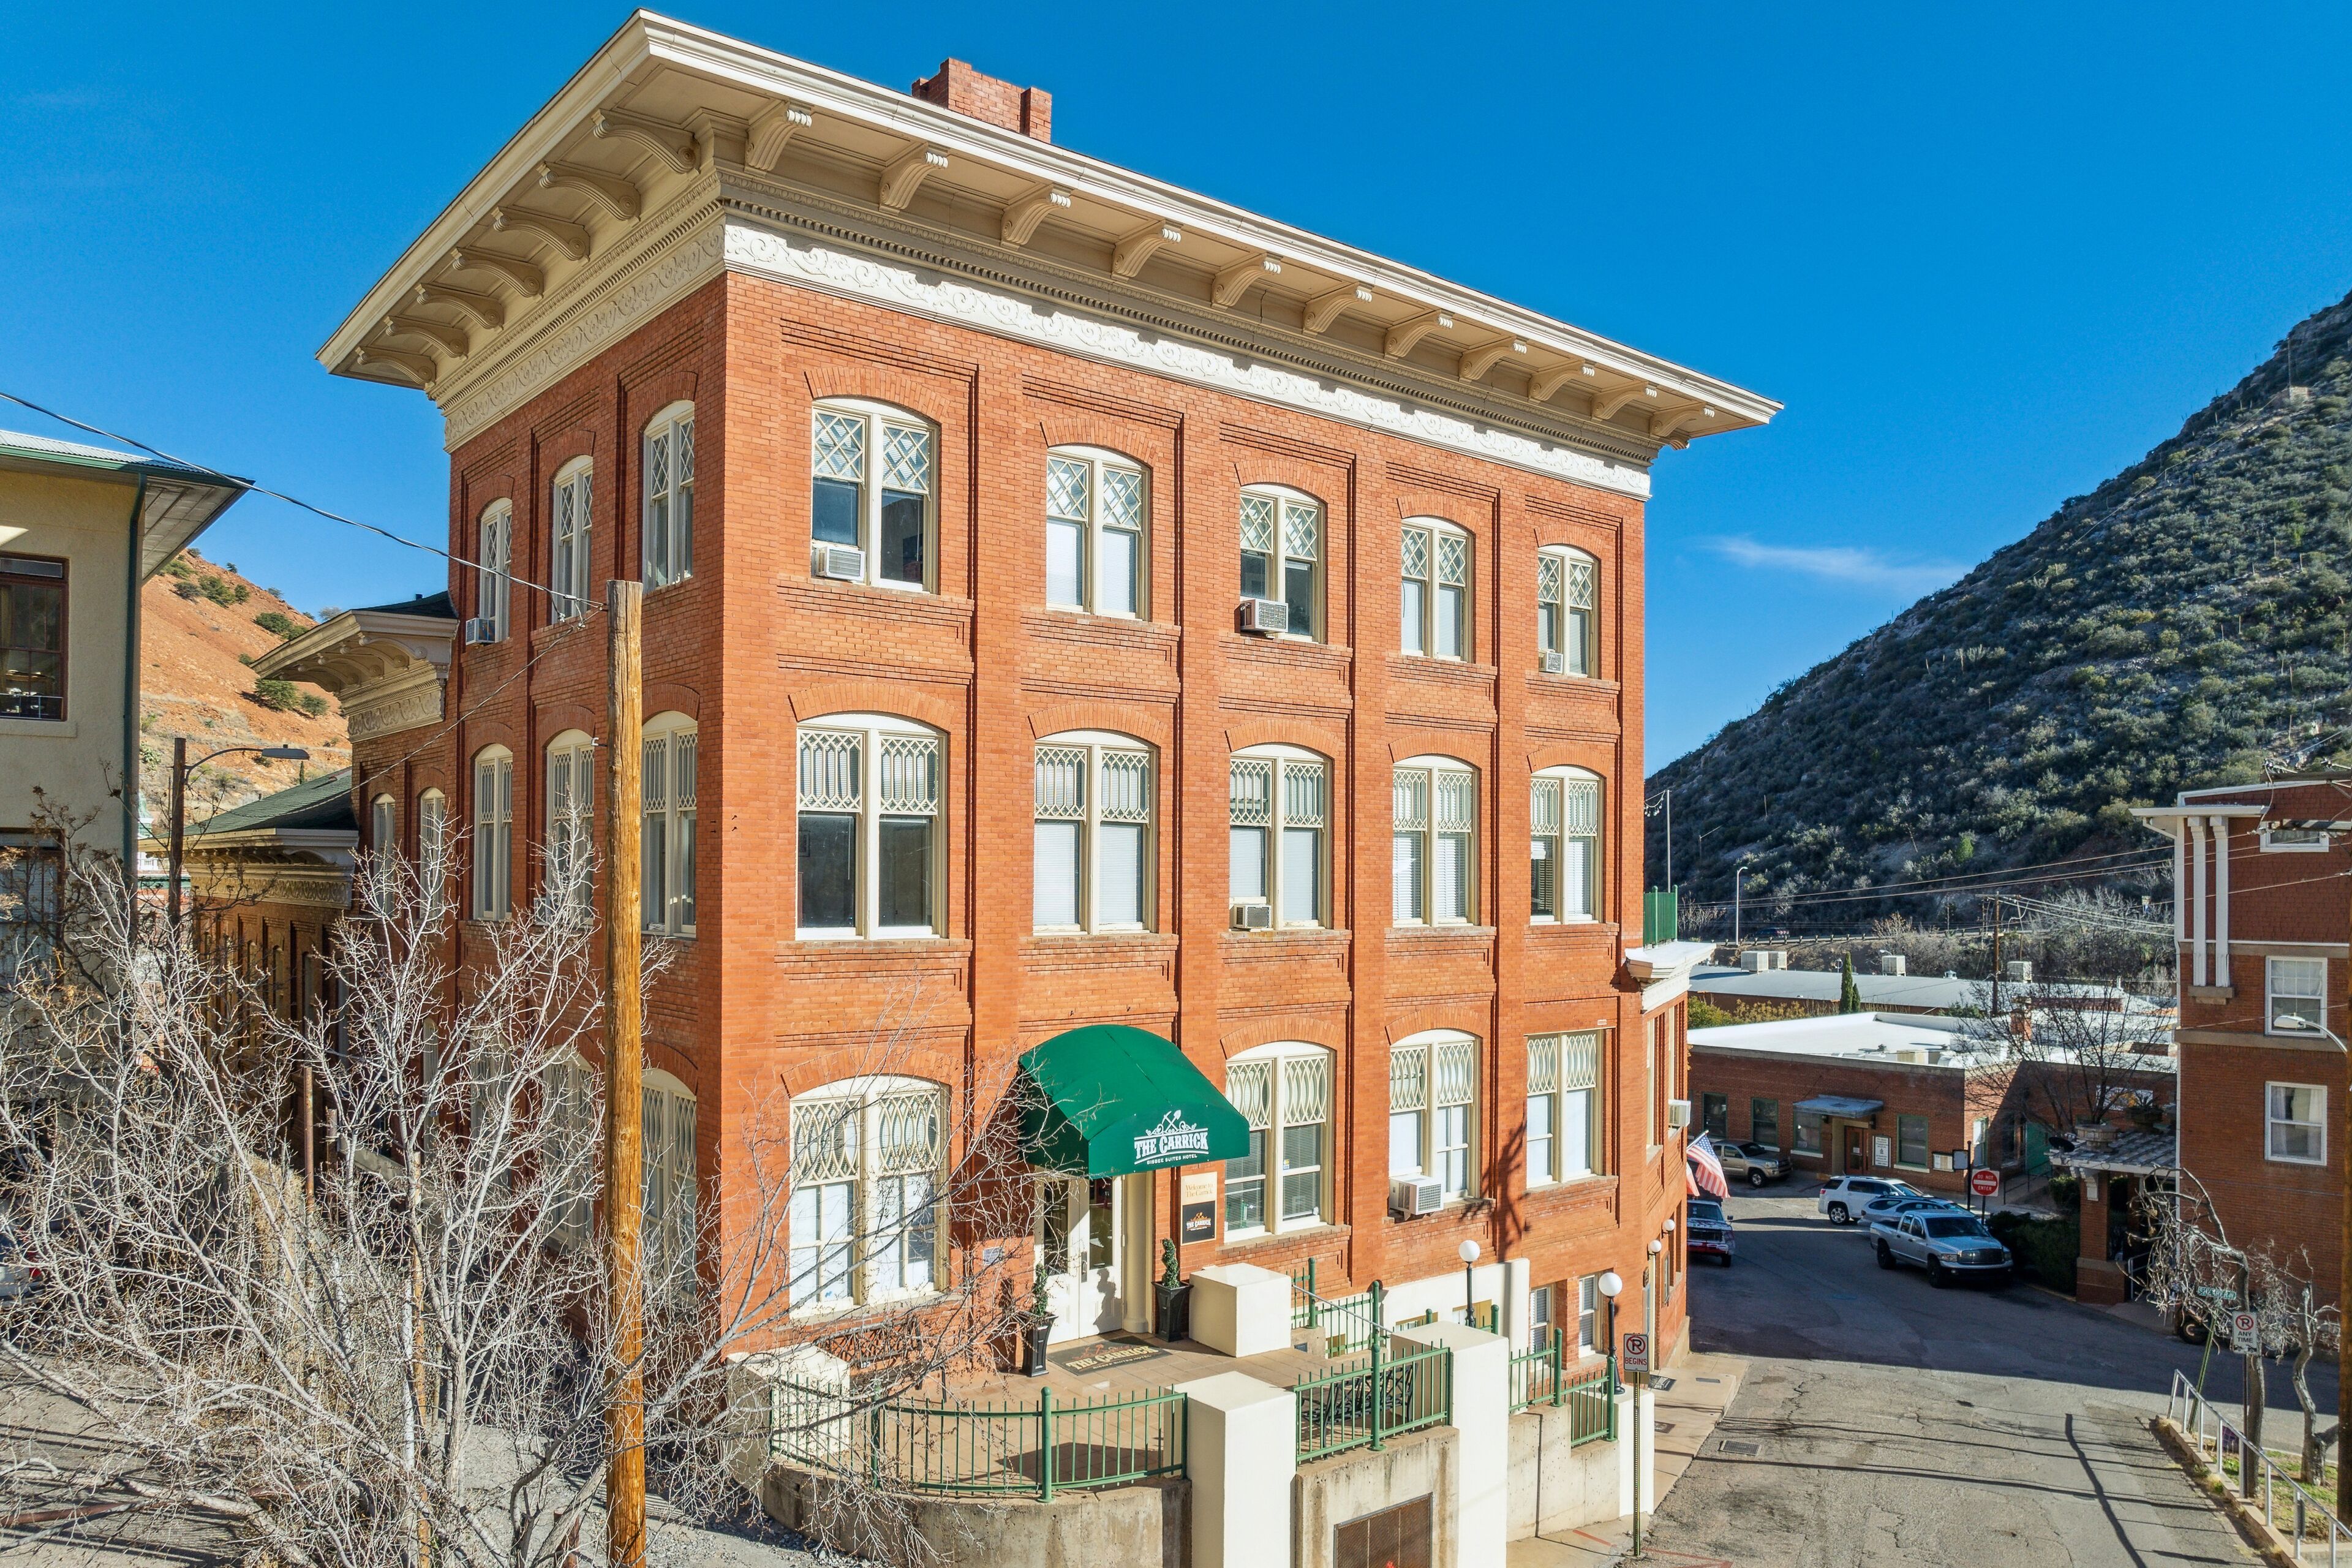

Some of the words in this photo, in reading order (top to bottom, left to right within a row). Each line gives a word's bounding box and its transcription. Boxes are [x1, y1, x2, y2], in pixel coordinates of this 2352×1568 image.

[1134, 1139, 1156, 1159] THE
[1159, 1131, 1208, 1153] CARRICK
[1194, 1219, 1212, 1228] CARRICK
[1066, 1358, 1097, 1370] THE
[1095, 1346, 1159, 1363] CARRICK
[1625, 1357, 1647, 1366] BEGINS
